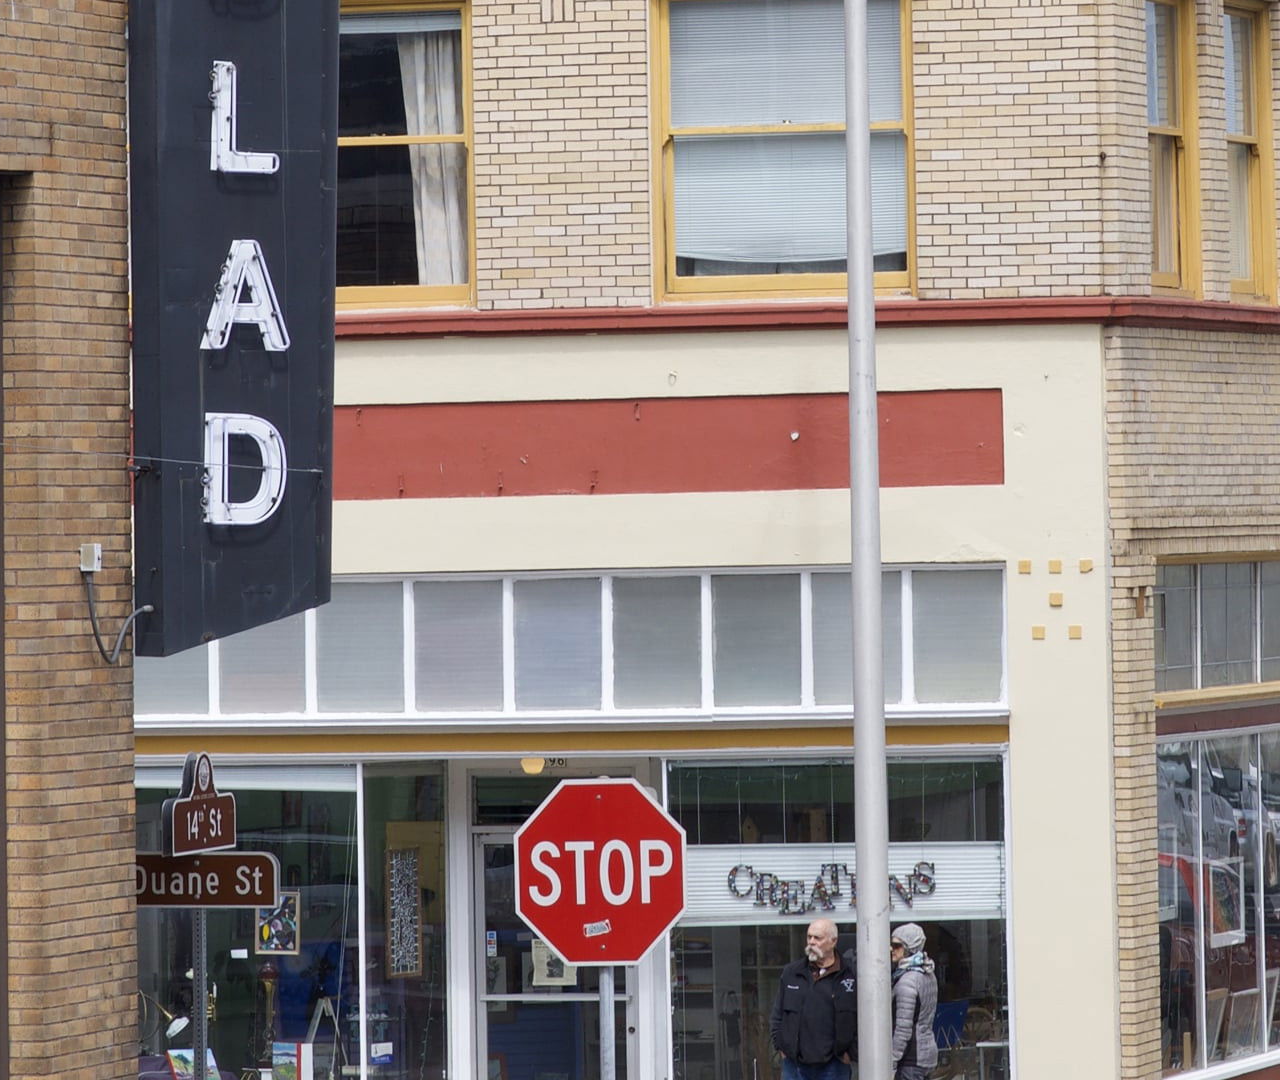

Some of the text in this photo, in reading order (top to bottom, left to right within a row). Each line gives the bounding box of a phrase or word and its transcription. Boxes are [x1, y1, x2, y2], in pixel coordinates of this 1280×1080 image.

[544, 757, 565, 767] 96
[209, 807, 222, 838] St
[136, 865, 263, 896] Duane St
[528, 839, 673, 907] STOP
[727, 861, 937, 915] CREATNS
